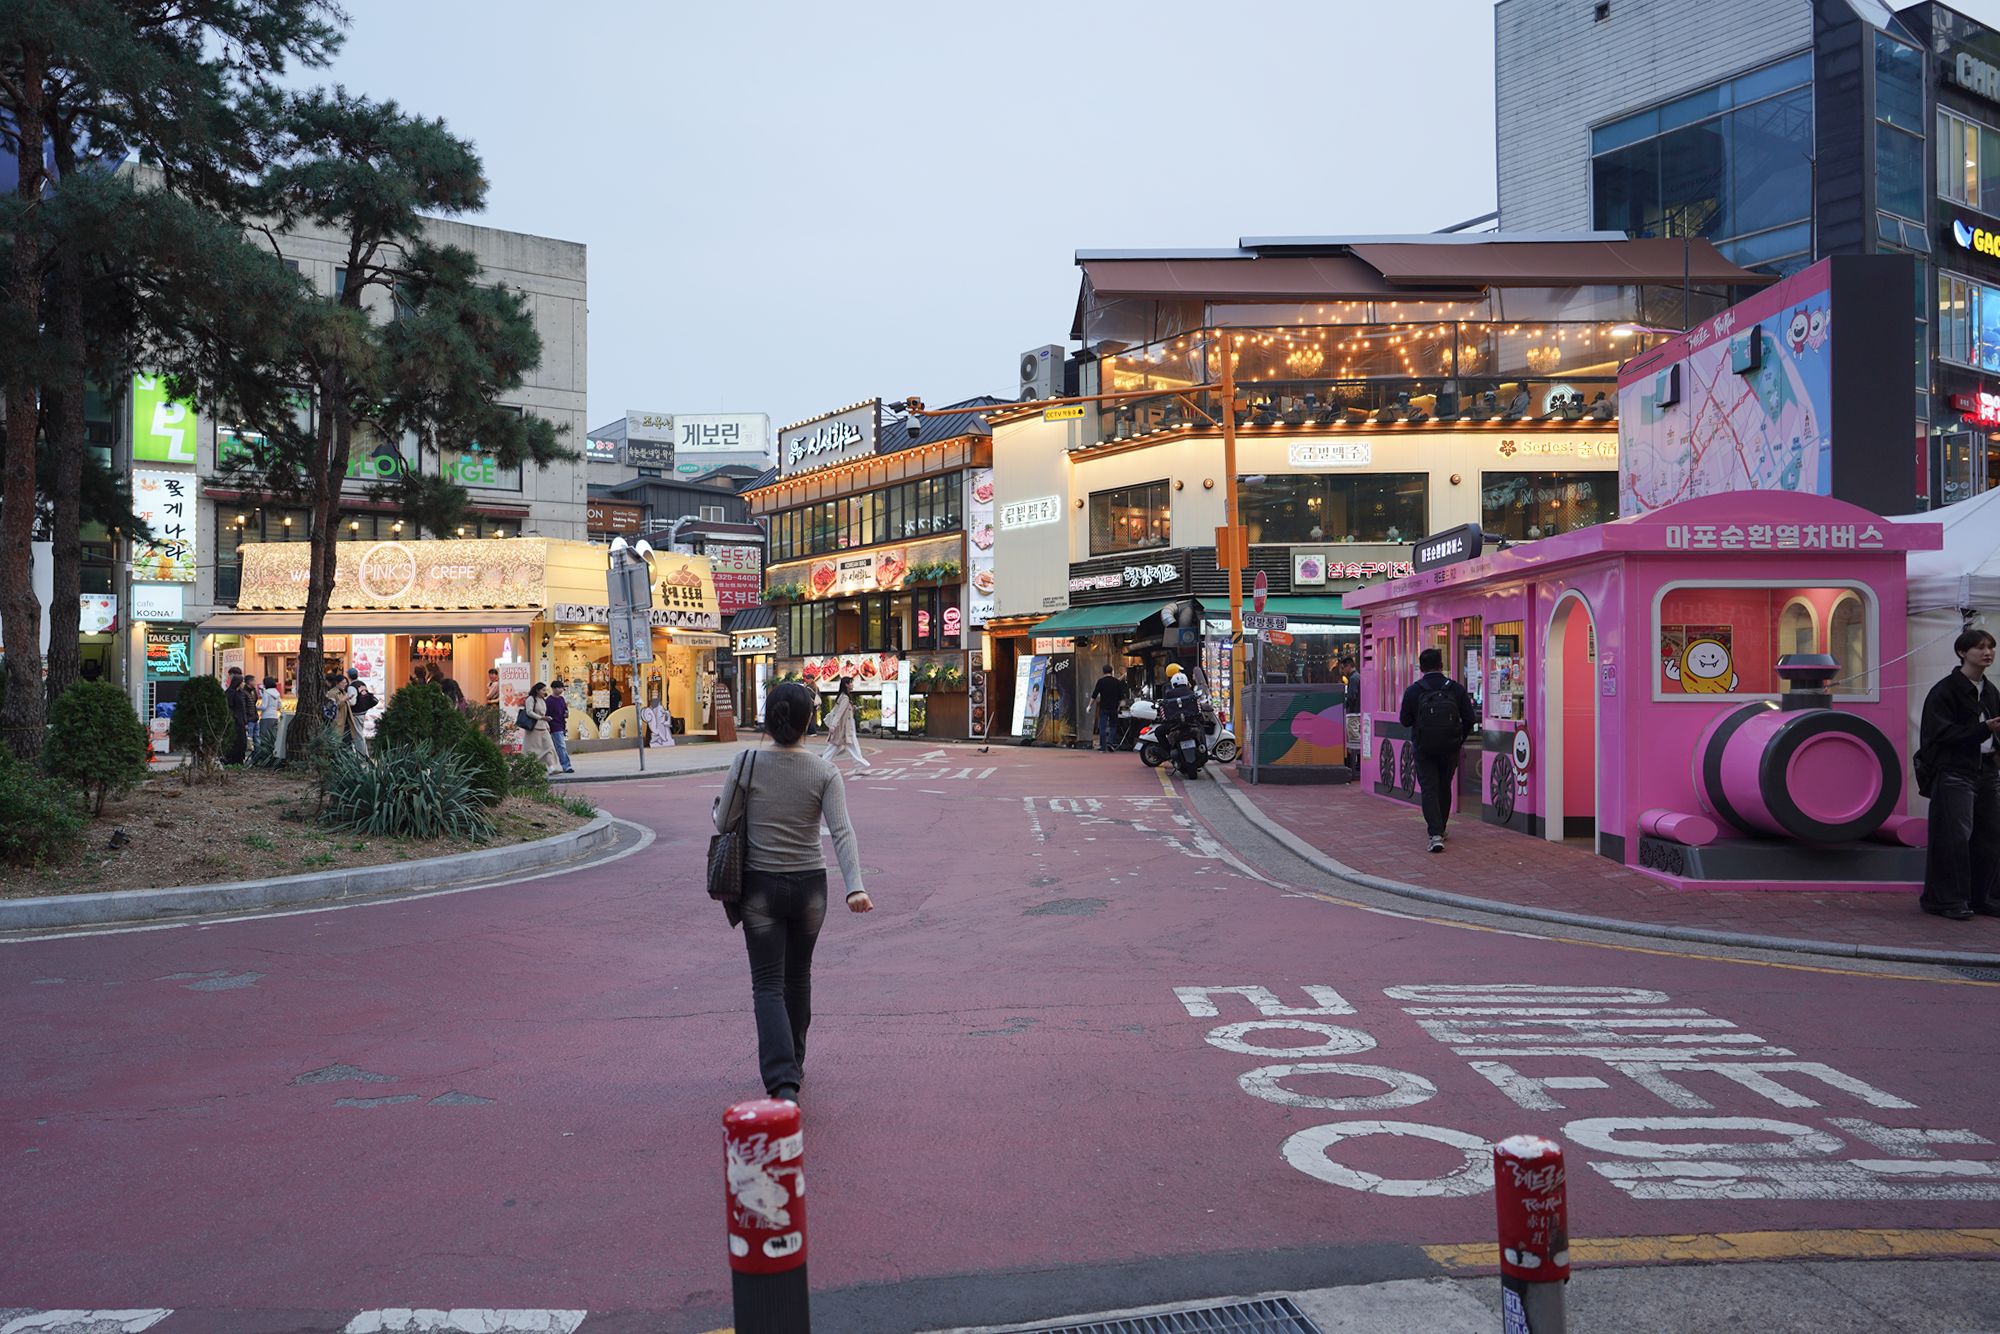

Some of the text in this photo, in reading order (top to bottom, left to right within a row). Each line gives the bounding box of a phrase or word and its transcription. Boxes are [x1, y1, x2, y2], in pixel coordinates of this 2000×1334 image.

[1046, 411, 1062, 419] CCTV
[682, 423, 739, 446] 게보린
[1523, 440, 1573, 453] Series:
[164, 479, 187, 561] 꽃게나라
[1666, 525, 1884, 549] 마포순환열차버스
[721, 548, 756, 569] 부동산
[364, 563, 412, 580] PINK'S
[431, 565, 475, 580] CREPE
[1247, 616, 1285, 629] 일방통행
[148, 634, 190, 643] TAKE OUT
[1055, 659, 1069, 672] Cass
[501, 672, 529, 680] COFFEE
